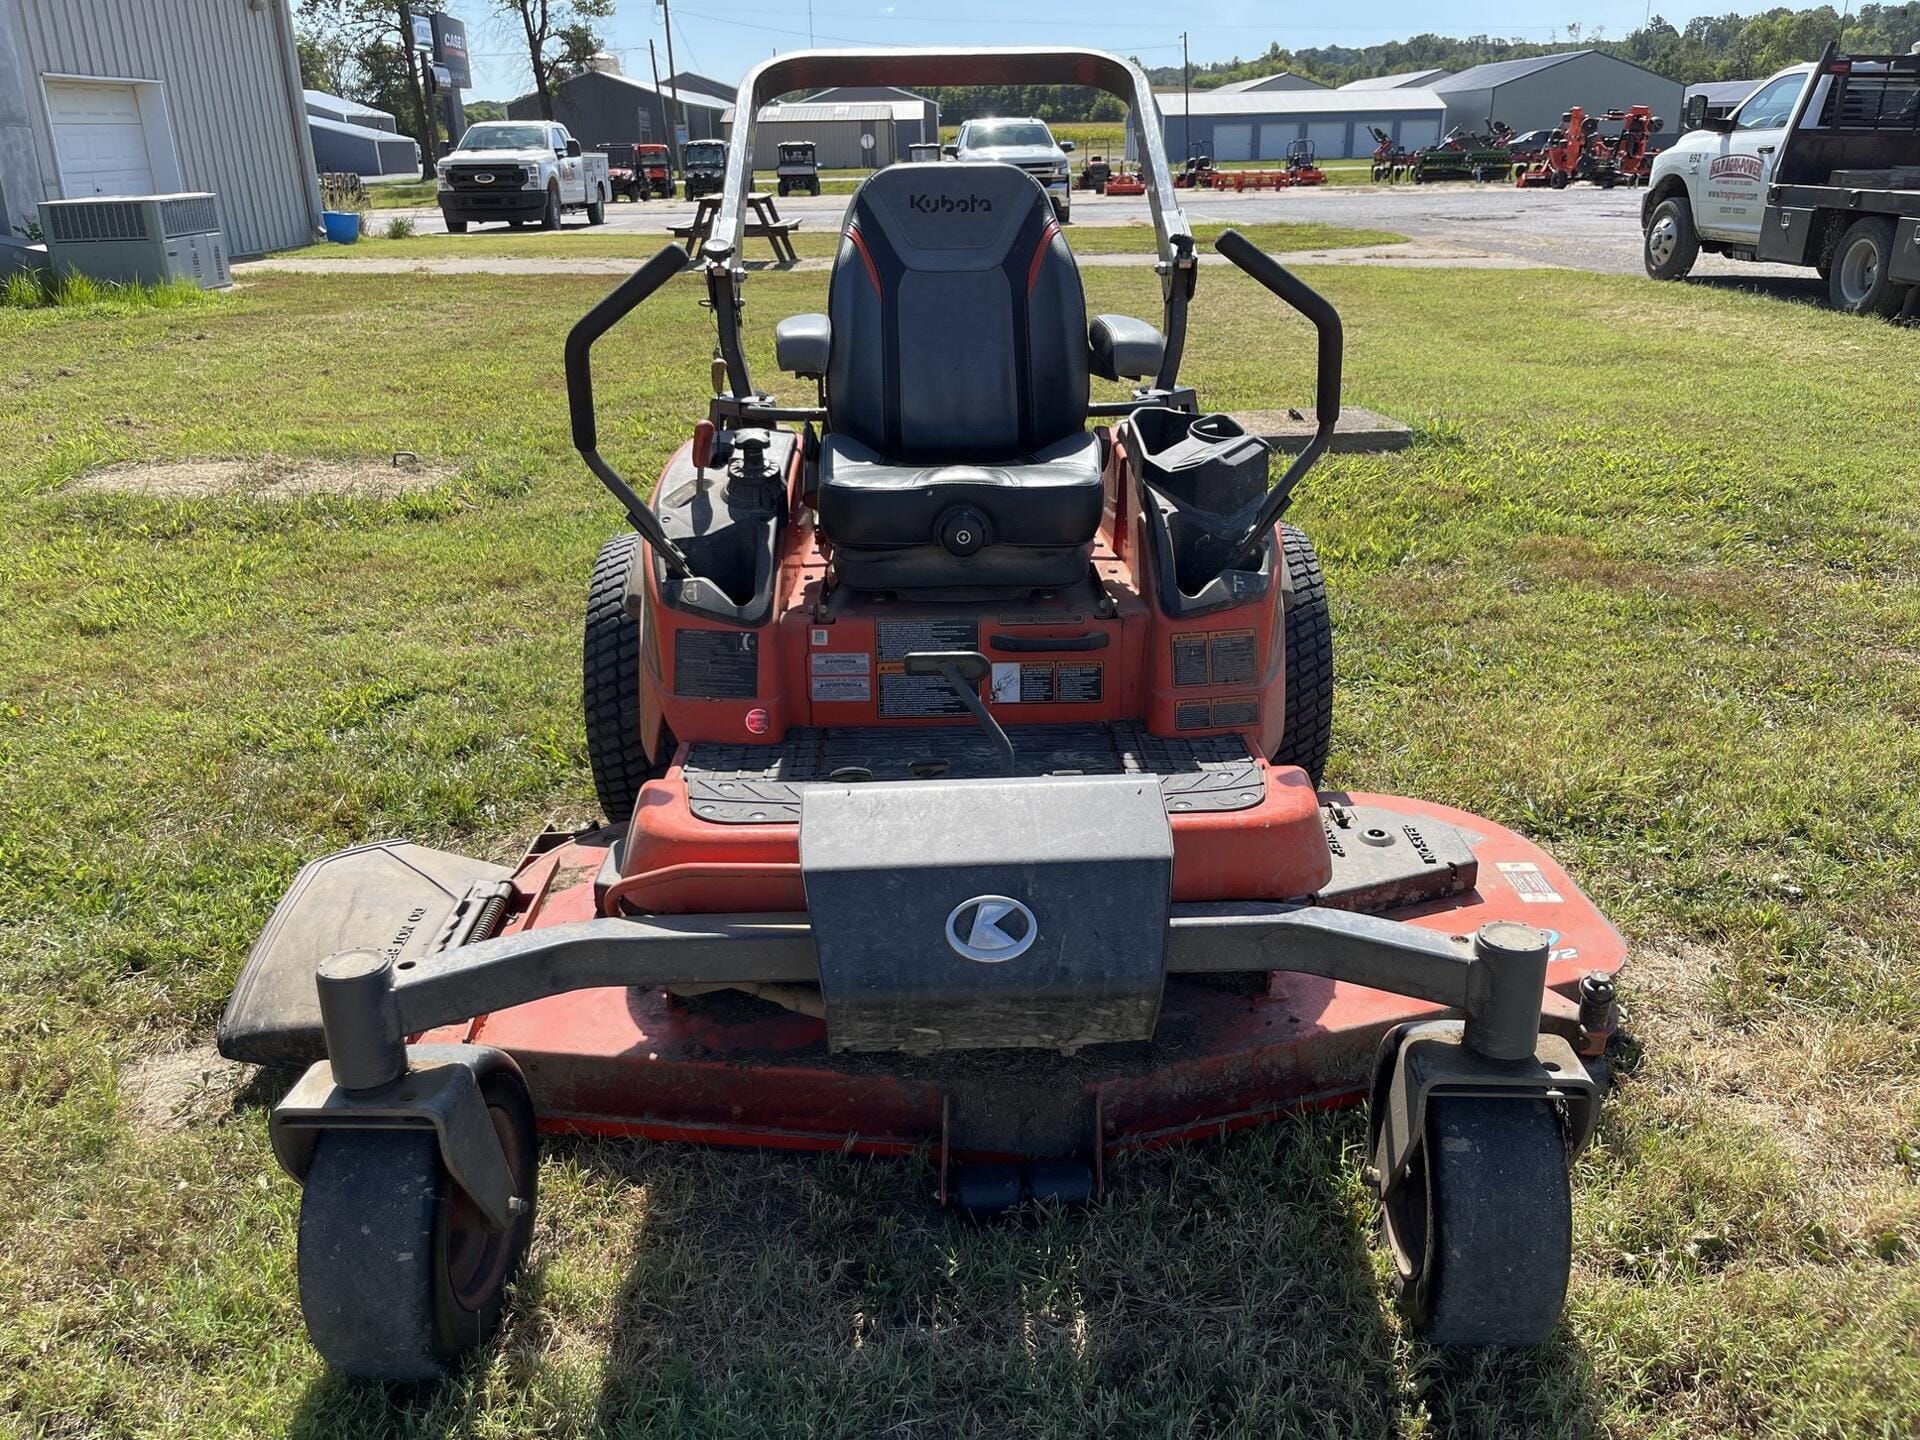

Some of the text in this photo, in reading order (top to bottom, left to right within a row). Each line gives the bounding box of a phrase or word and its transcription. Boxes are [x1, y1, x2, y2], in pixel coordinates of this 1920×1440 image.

[444, 33, 462, 48] CASE
[1689, 153, 1702, 163] 692
[910, 194, 992, 213] Kubota
